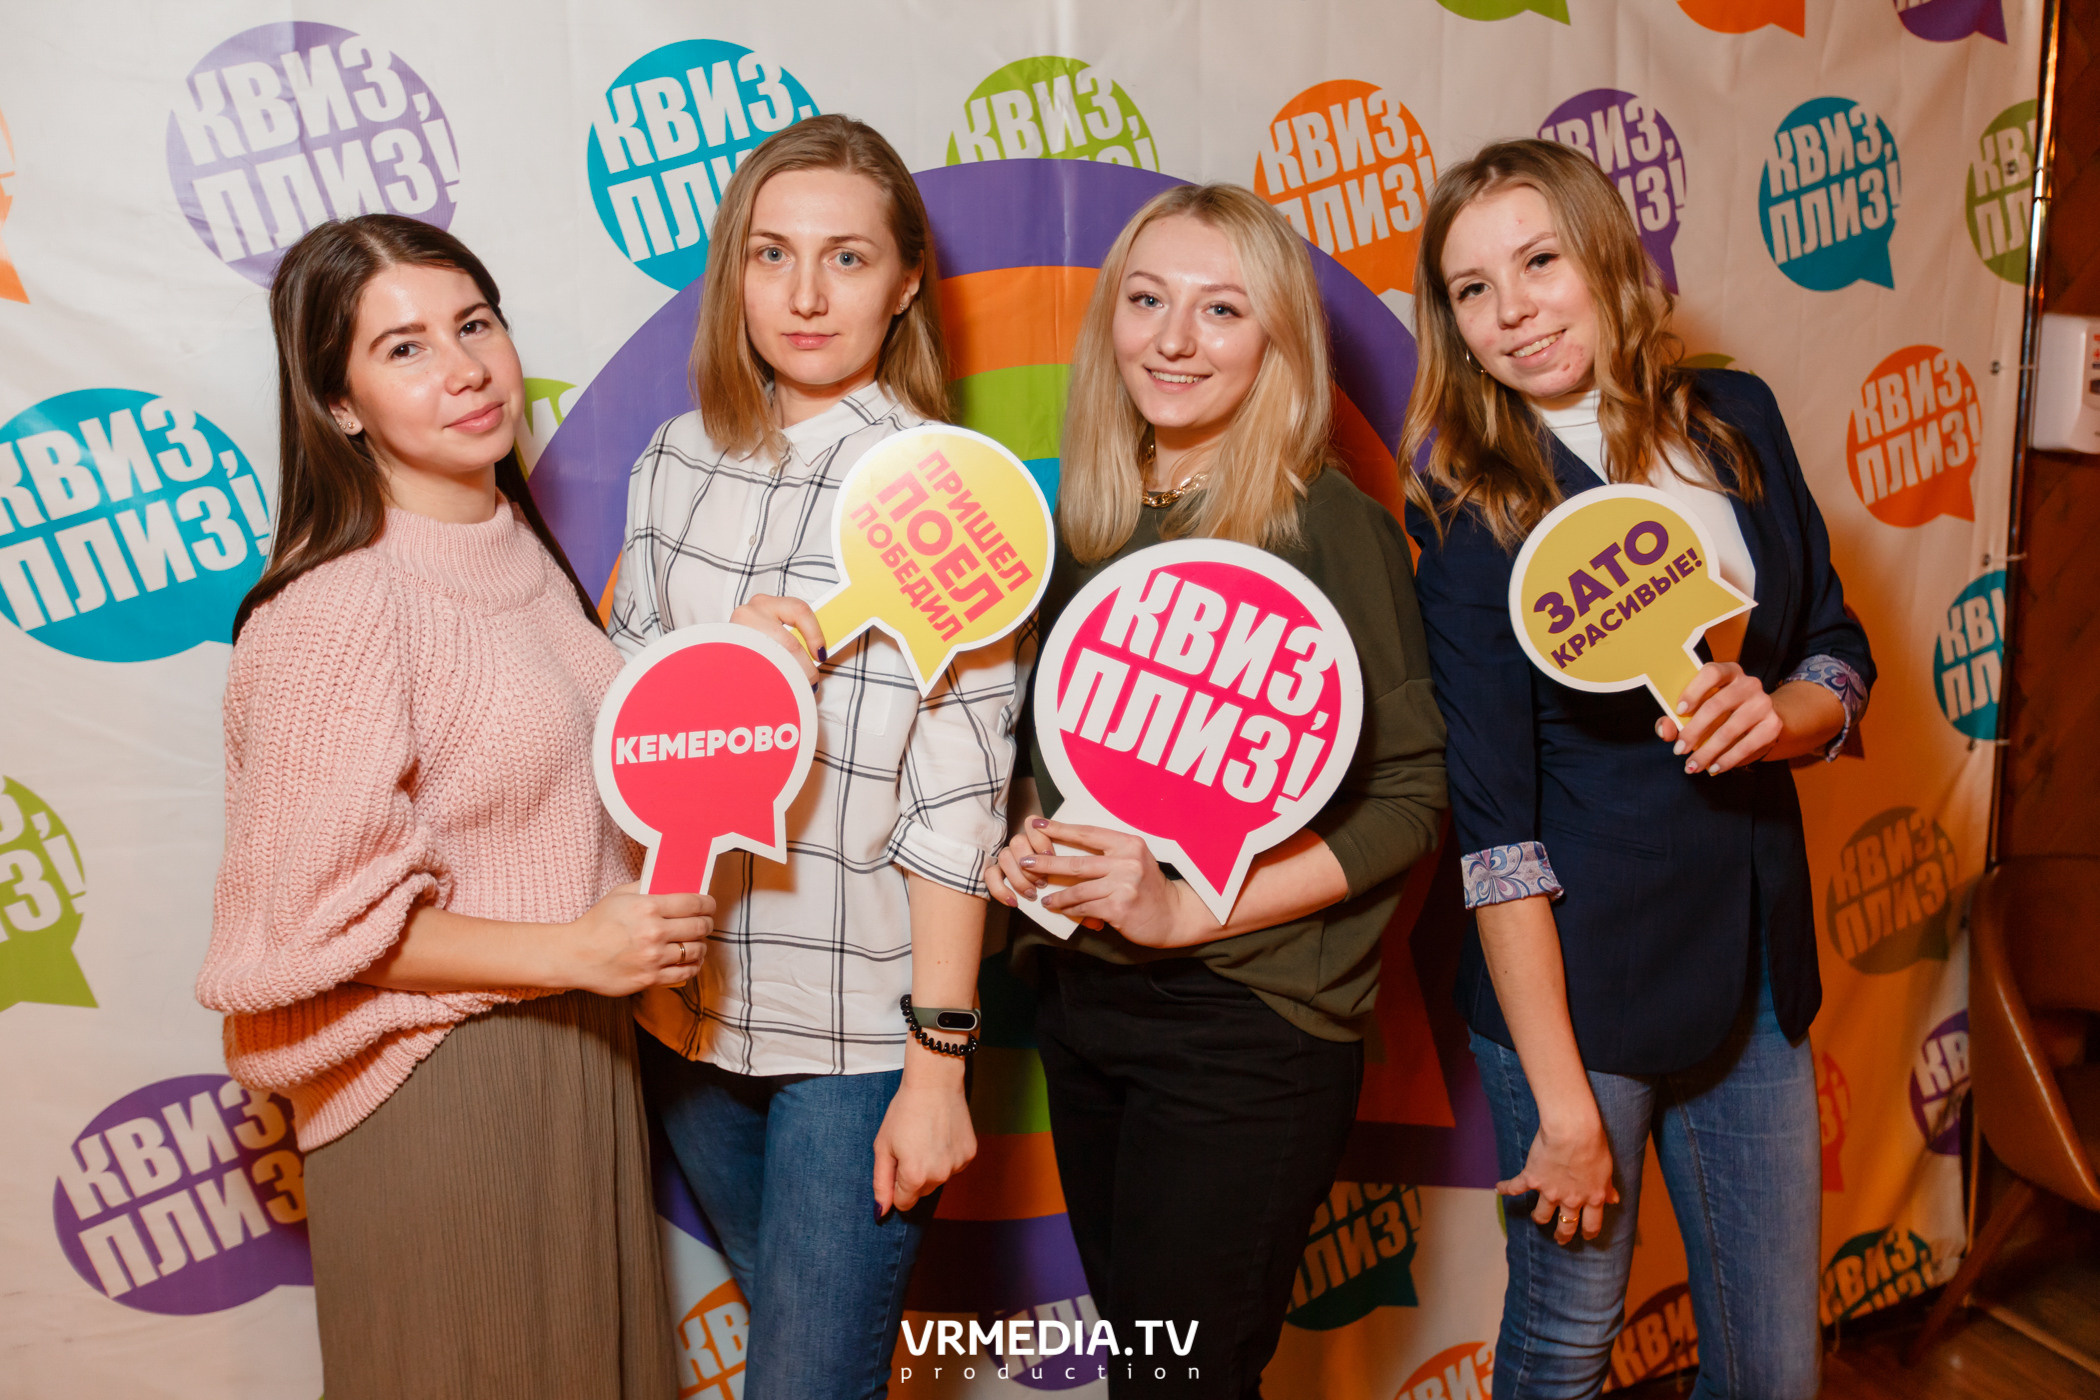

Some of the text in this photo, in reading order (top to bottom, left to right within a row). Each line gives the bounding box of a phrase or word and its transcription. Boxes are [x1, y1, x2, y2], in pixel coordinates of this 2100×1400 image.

[172, 34, 431, 167] КВИЗ,
[952, 65, 1141, 164] КВИЗ,
[1259, 88, 1424, 196] КВИЗ,
[1766, 104, 1894, 198] КВИЗ,
[1768, 160, 1900, 266] ПЛИЗ!
[1853, 351, 1973, 445] КВИЗ,
[1856, 402, 1981, 507] ПЛИЗ!
[0, 473, 272, 633] ПЛИЗ!
[849, 500, 965, 643] ПОБЕДИЛ
[875, 470, 1005, 624] ПОЕЛ
[916, 449, 1033, 592] ПРИШЕЛ
[1533, 520, 1669, 634] ЗАТО
[1099, 571, 1335, 731] КВИЗ,
[1550, 547, 1703, 669] КРАСИВЫЕ!
[615, 723, 800, 765] КЕМЕРОВО
[1057, 647, 1326, 815] ПЛИЗ!
[1832, 811, 1949, 904] КВИЗ,
